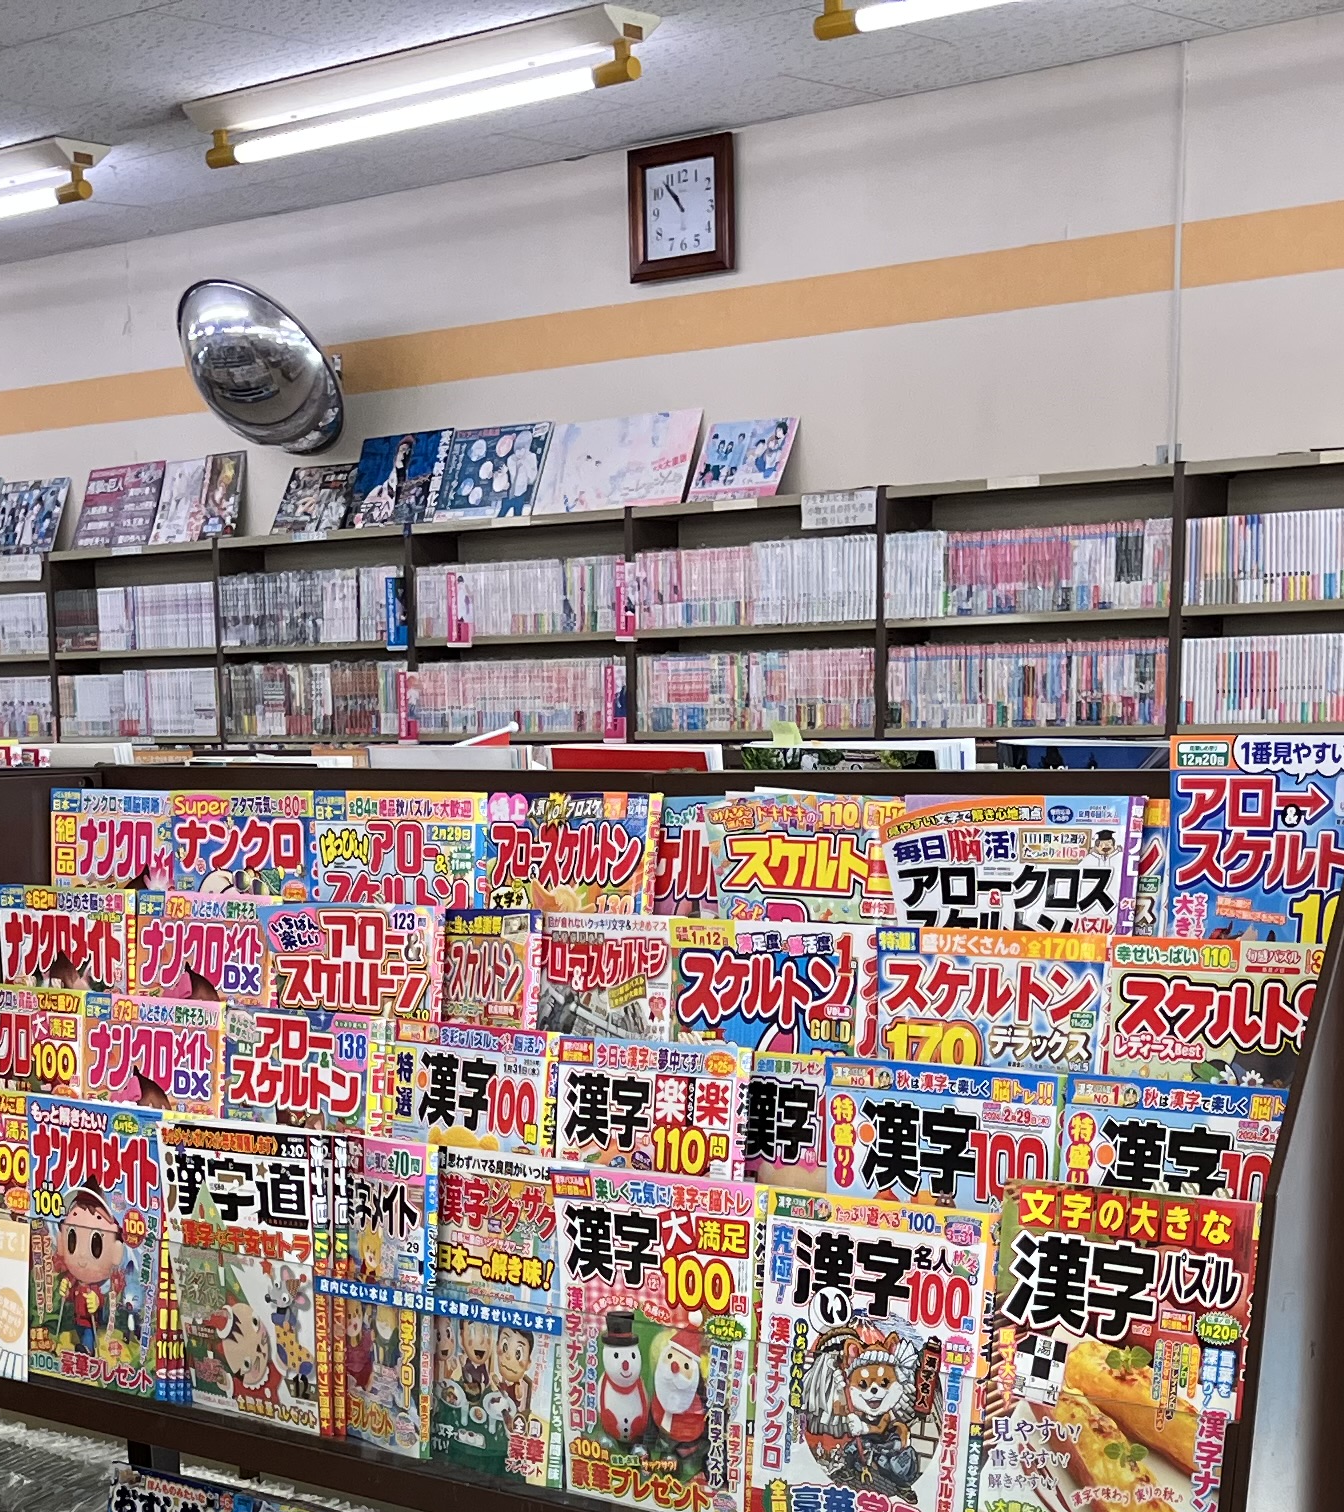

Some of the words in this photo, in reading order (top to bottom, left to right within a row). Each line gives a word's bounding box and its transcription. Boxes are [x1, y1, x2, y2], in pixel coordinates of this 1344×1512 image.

[678, 169, 688, 183] 12
[694, 169, 698, 182] 1
[705, 177, 711, 191] 2
[653, 188, 663, 200] 10
[707, 199, 714, 213] 3
[653, 208, 660, 222] 9
[705, 221, 711, 233] 4
[656, 227, 662, 241] 8
[668, 238, 674, 251] 7
[680, 238, 687, 250] 6
[694, 234, 700, 248] 5
[1182, 754, 1225, 766] 12月20日
[175, 796, 228, 816] Super
[757, 806, 816, 823] ドキドキの
[56, 815, 76, 875] 絶品
[177, 820, 303, 871] ナンクロ
[432, 827, 470, 841] 2月29日
[435, 856, 448, 873] &
[898, 865, 1115, 911] アロークロス
[989, 890, 1001, 906] &
[272, 914, 318, 931] いちばん
[5, 913, 119, 982] ナンクロメイト
[280, 934, 318, 949] 楽しい
[323, 914, 404, 958] アロー
[406, 934, 423, 961] &
[922, 935, 1020, 956] 盛りだくさんの
[142, 920, 261, 987] ナンクロメイト
[1116, 946, 1197, 965] 幸せいっぱい
[224, 966, 260, 992] DX
[280, 960, 427, 1011] スケルトン
[681, 955, 852, 1028] スケルトン
[885, 959, 1100, 1028] スケルトン
[49, 1019, 76, 1038] 満足
[811, 1019, 850, 1042] GOLD
[91, 1025, 210, 1091] ナンクロメイト
[337, 1034, 366, 1059] 138
[33, 1042, 75, 1081] 100
[320, 1052, 329, 1068] &
[175, 1072, 209, 1096] DX
[231, 1058, 361, 1114] スケルトン
[396, 1052, 414, 1116] 特選
[419, 1056, 488, 1128] 漢字
[488, 1077, 535, 1136] 100
[896, 1072, 990, 1098] 秋は漢字で楽しく
[566, 1071, 651, 1149] 漢字
[653, 1127, 707, 1174] 110
[710, 1135, 727, 1163] 問
[860, 1101, 977, 1195] 漢字
[32, 1124, 159, 1210] ナンクロメイト
[835, 1205, 901, 1229] たっぷり遊べる
[1022, 1190, 1233, 1245] 文字の大きな
[568, 1206, 660, 1286] 漢字
[698, 1223, 747, 1252] 満足
[913, 1248, 952, 1274] 名人
[663, 1259, 730, 1311] 100
[731, 1294, 747, 1313] 問
[1005, 1234, 1157, 1339] 漢字
[1159, 1253, 1243, 1309] パズル
[320, 1282, 388, 1302] 店内にない本は
[392, 1289, 435, 1312] 最短3日
[438, 1300, 556, 1333] でお取り寄せいたします
[908, 1273, 970, 1331] 100
[61, 1350, 154, 1393] 豪華プレゼント
[566, 1287, 585, 1432] 漢字ナンクロ
[763, 1315, 790, 1470] 漢字ナンクロ
[993, 1419, 1082, 1443] 見やすい!
[990, 1449, 1069, 1470] 書きやすい!
[988, 1473, 1059, 1491] 解きやすい!
[1073, 1486, 1130, 1507] 漢字で味わう
